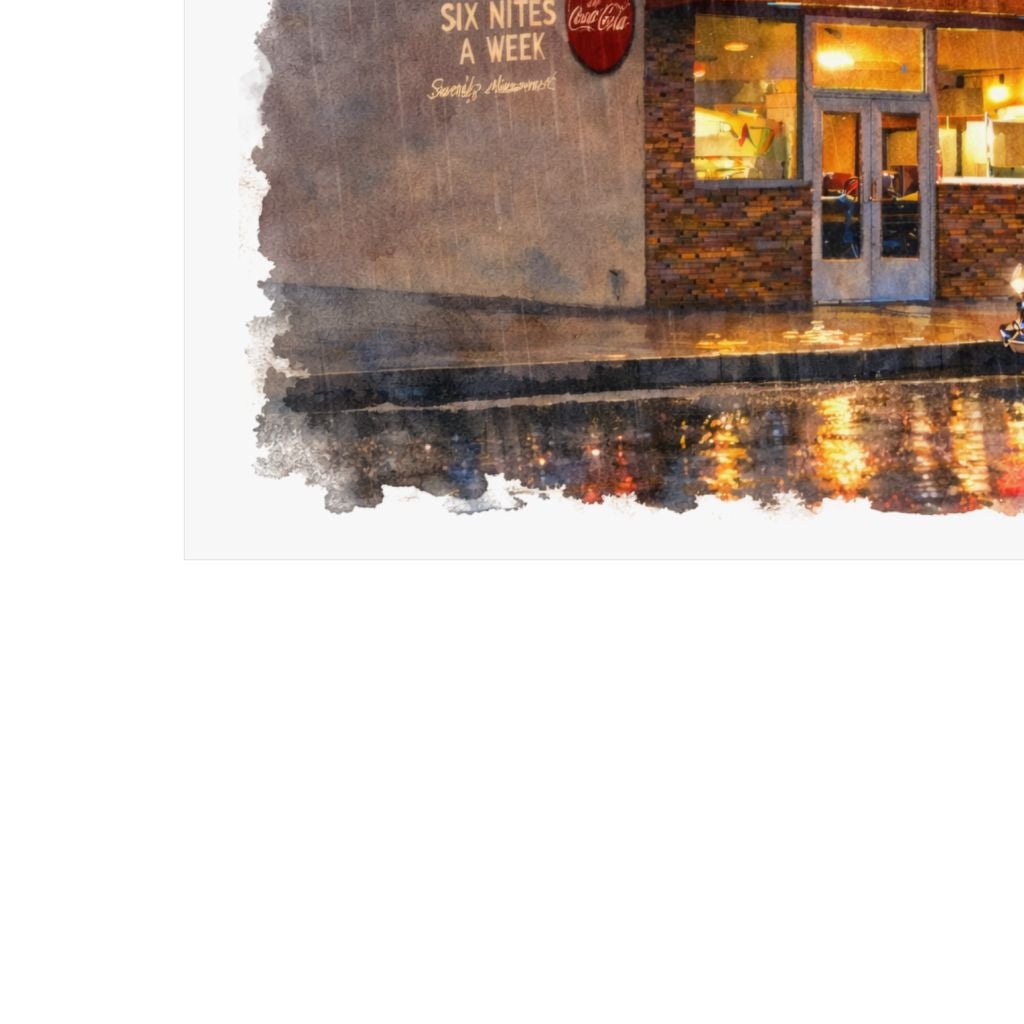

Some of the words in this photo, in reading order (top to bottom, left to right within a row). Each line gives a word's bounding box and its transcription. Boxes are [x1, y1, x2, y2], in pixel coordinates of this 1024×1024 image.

[440, 2, 481, 32] SIX
[459, 38, 475, 65] A
[485, 32, 546, 63] WEEK
